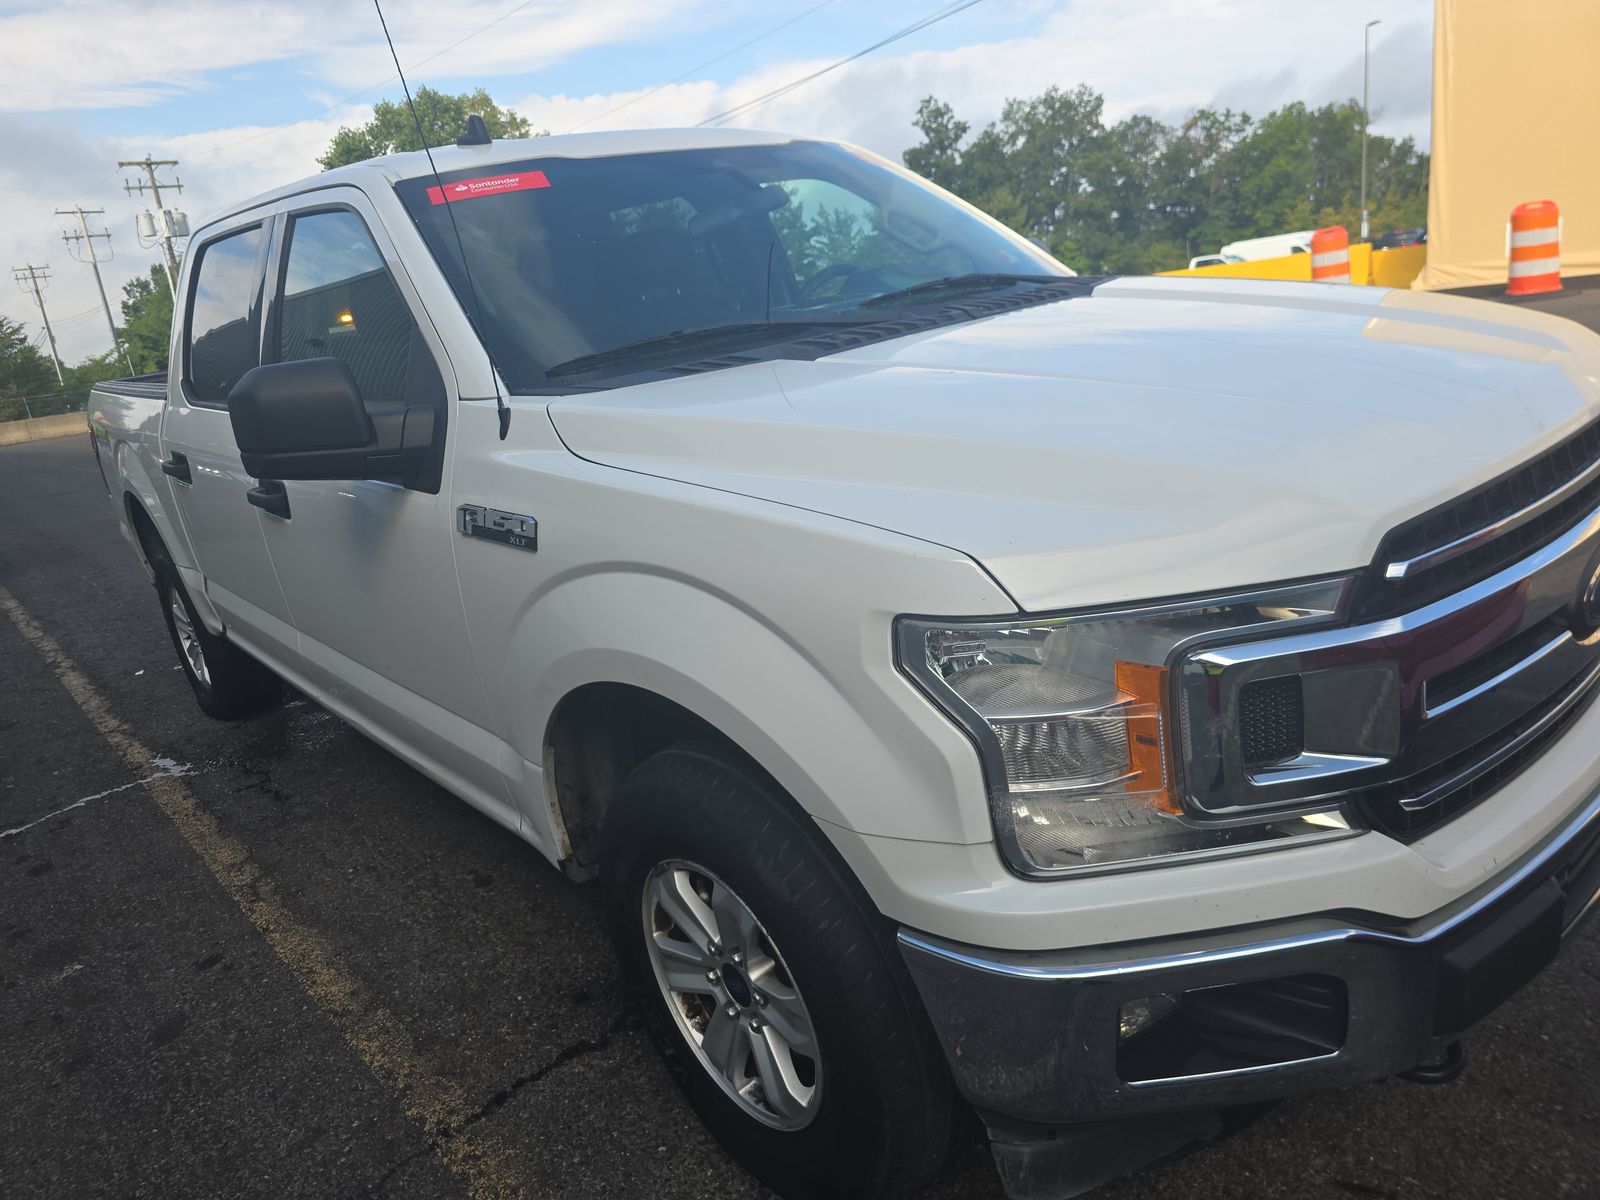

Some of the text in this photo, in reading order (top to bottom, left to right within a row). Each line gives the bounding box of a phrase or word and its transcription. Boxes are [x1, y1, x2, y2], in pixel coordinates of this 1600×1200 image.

[469, 178, 520, 188] Santander
[471, 185, 504, 193] Consumer
[510, 536, 526, 546] XLT
